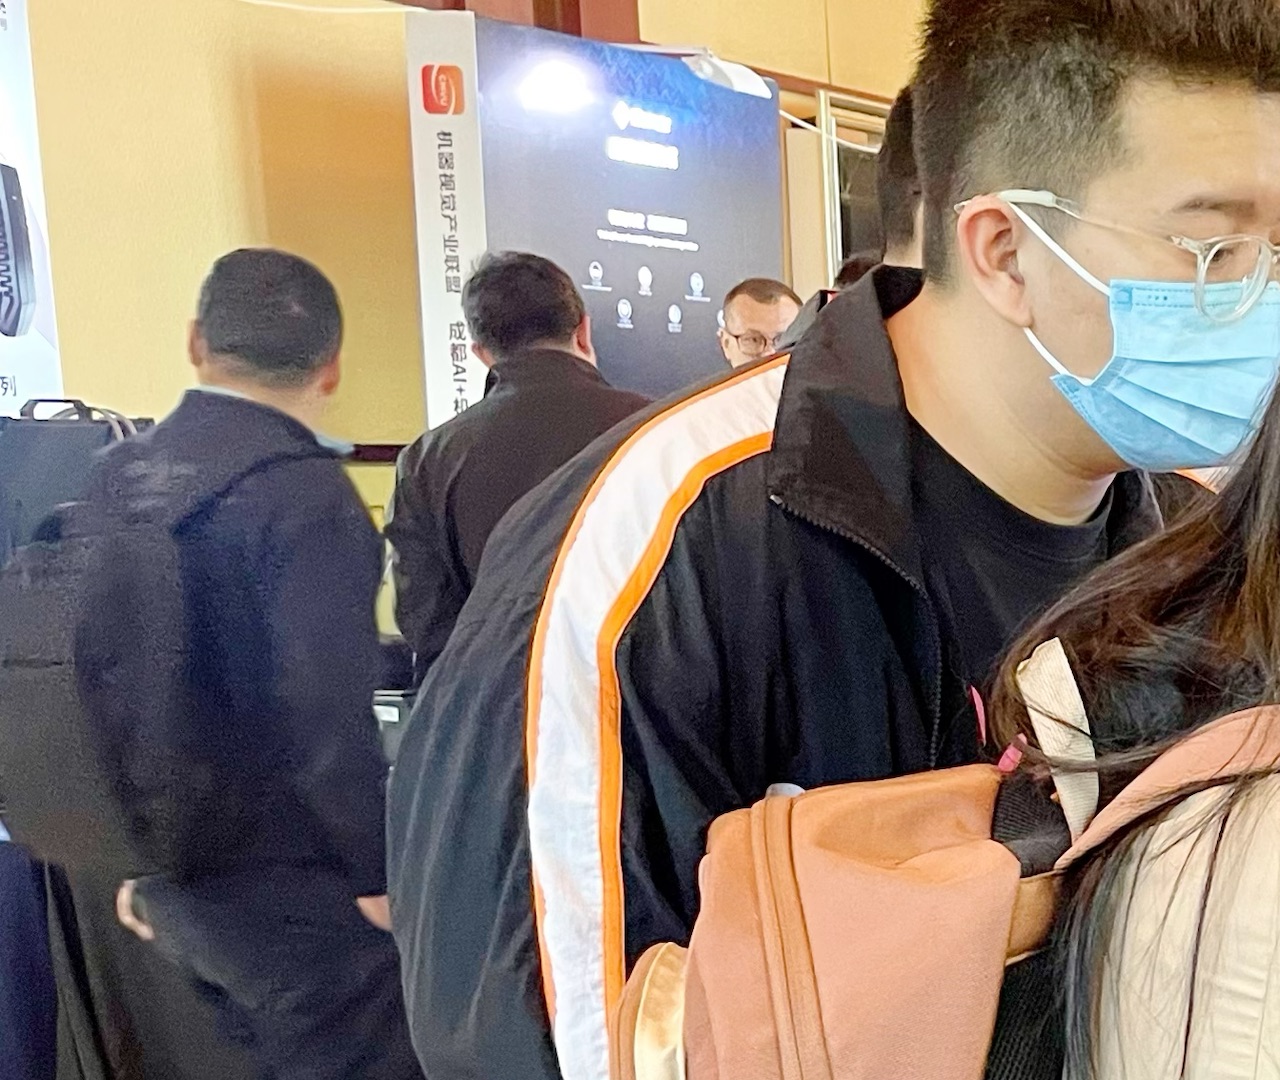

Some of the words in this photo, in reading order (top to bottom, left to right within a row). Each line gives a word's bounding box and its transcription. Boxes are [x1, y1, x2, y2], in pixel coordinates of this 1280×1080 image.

[436, 130, 461, 294] 机器视觉产业联盟
